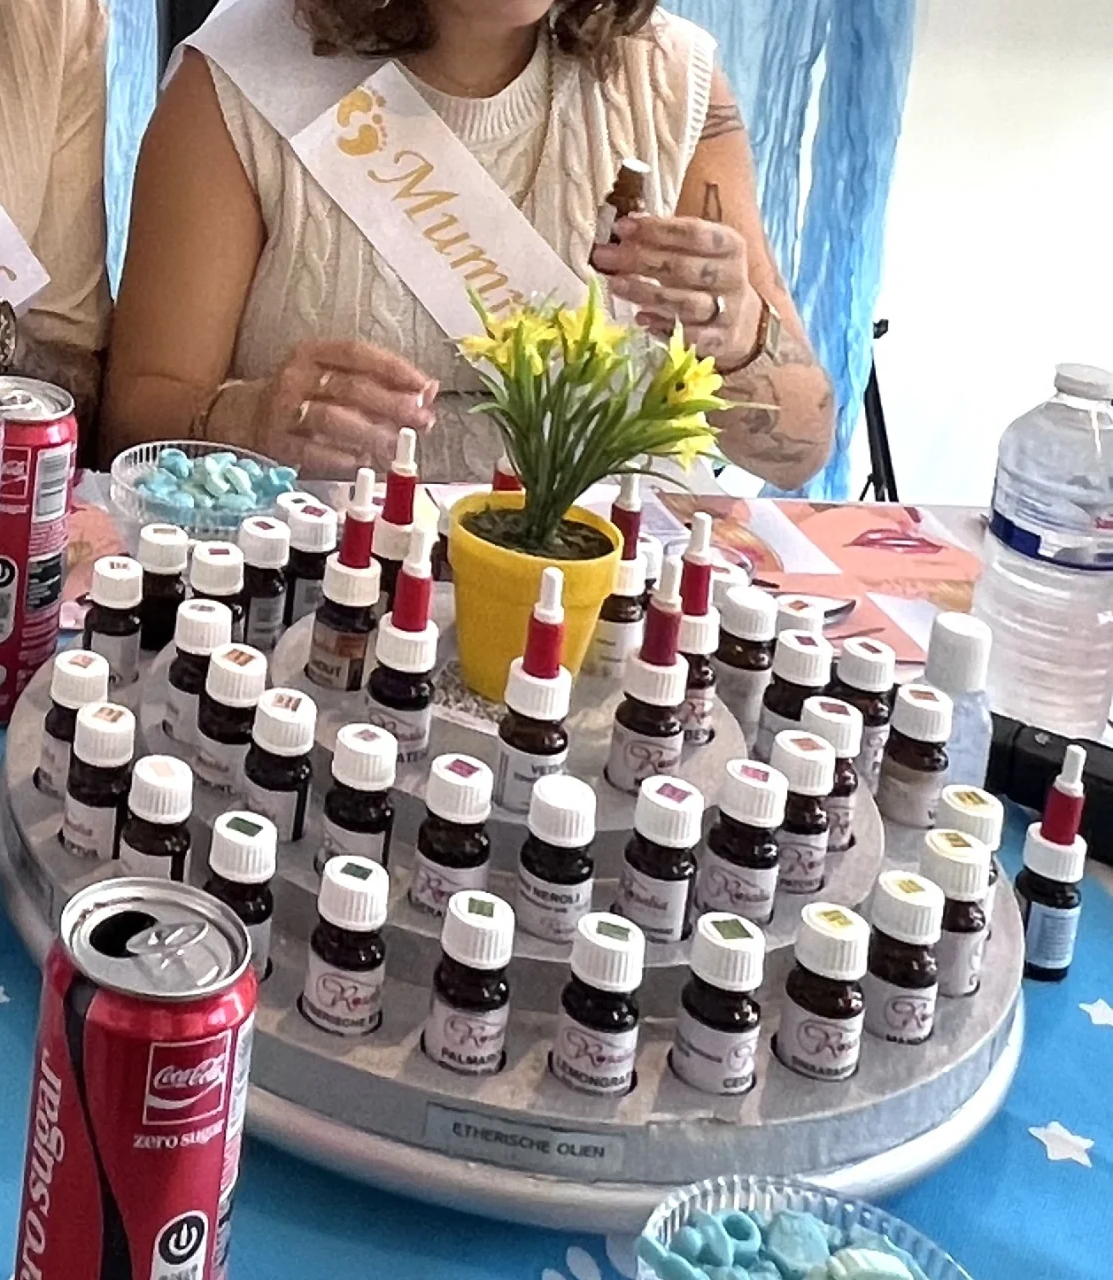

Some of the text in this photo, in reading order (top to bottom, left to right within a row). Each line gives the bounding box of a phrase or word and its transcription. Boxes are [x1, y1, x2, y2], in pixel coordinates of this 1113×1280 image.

[28, 1047, 65, 1218] sugar
[133, 1134, 178, 1149] zero
[452, 1121, 605, 1158] ETHERISCHE OLIEN
